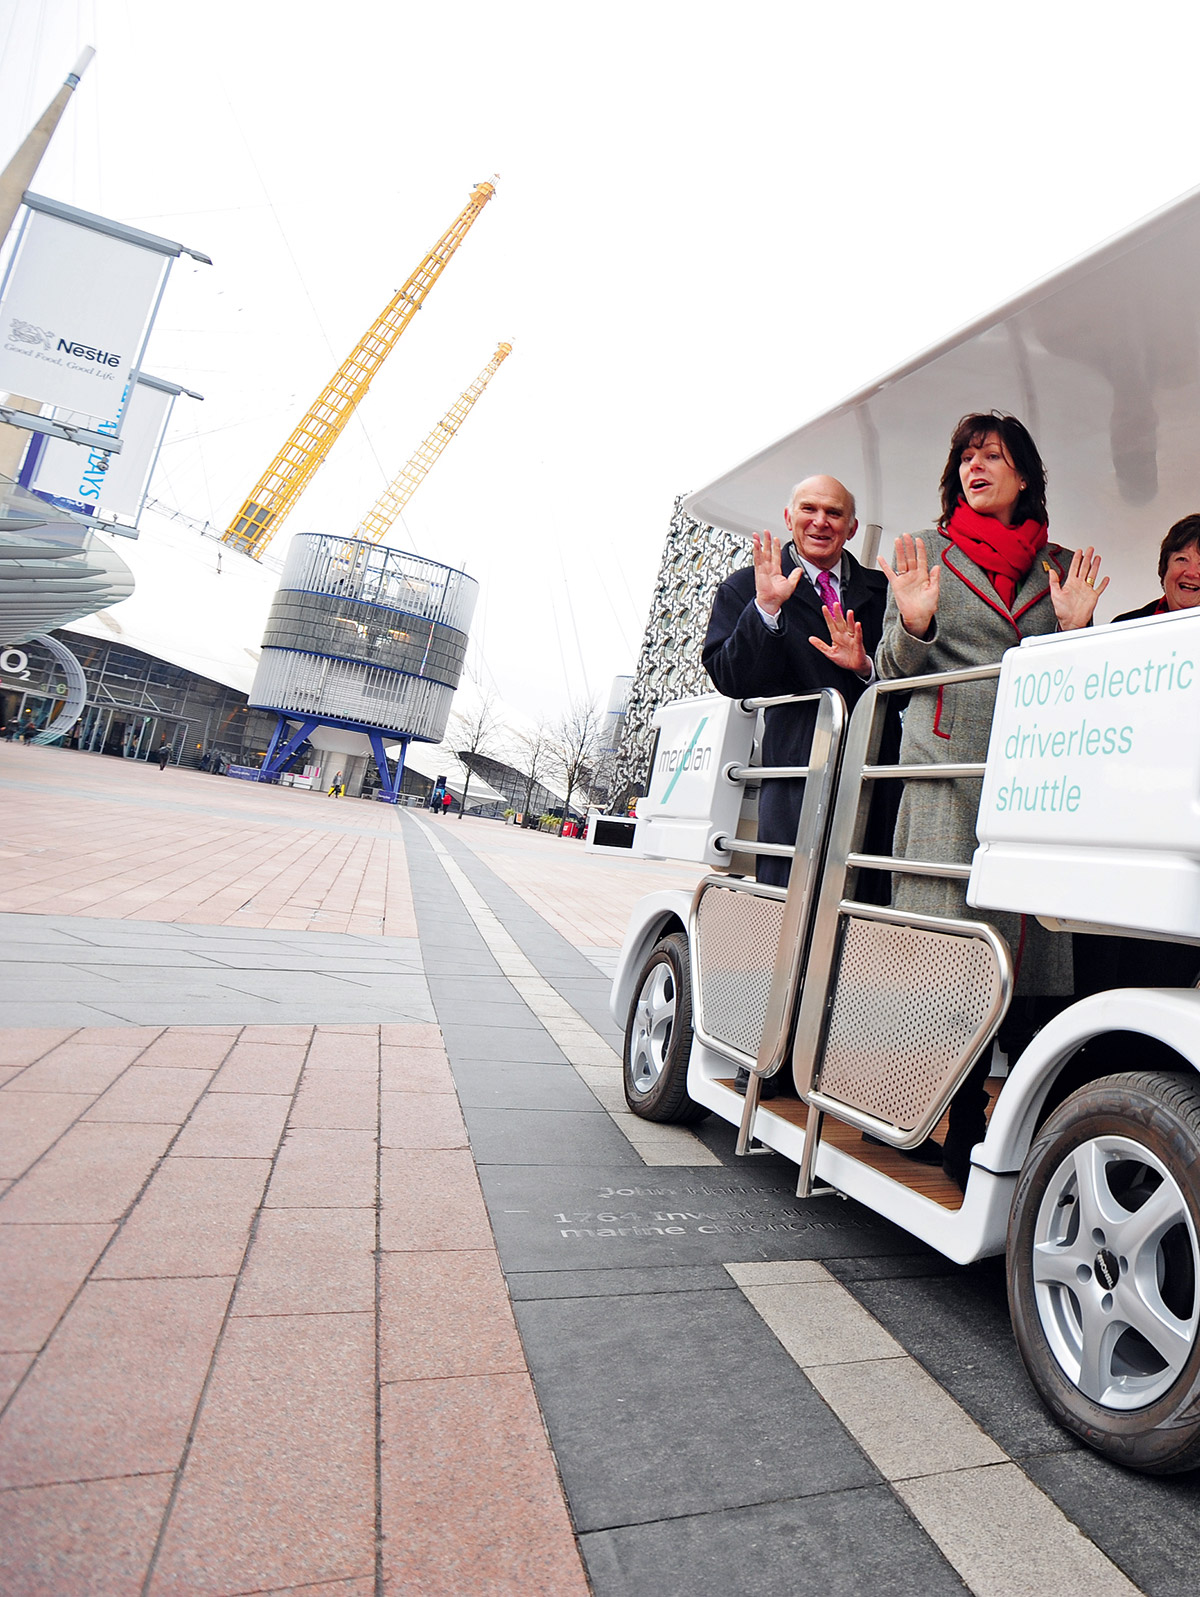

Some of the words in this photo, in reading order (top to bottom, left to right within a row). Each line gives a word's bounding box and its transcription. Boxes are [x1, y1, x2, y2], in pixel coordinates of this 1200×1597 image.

[4, 343, 34, 357] Good
[34, 351, 63, 366] Food,
[66, 361, 94, 375] Good
[96, 370, 115, 381] Life
[57, 338, 121, 367] Nestlé
[1014, 666, 1073, 708] 100%
[1084, 651, 1194, 700] electric
[1005, 719, 1133, 759] driverless
[657, 741, 712, 773] meridian
[996, 775, 1081, 812] shuttle
[553, 1212, 642, 1223] 1764
[560, 1225, 687, 1238] marine
